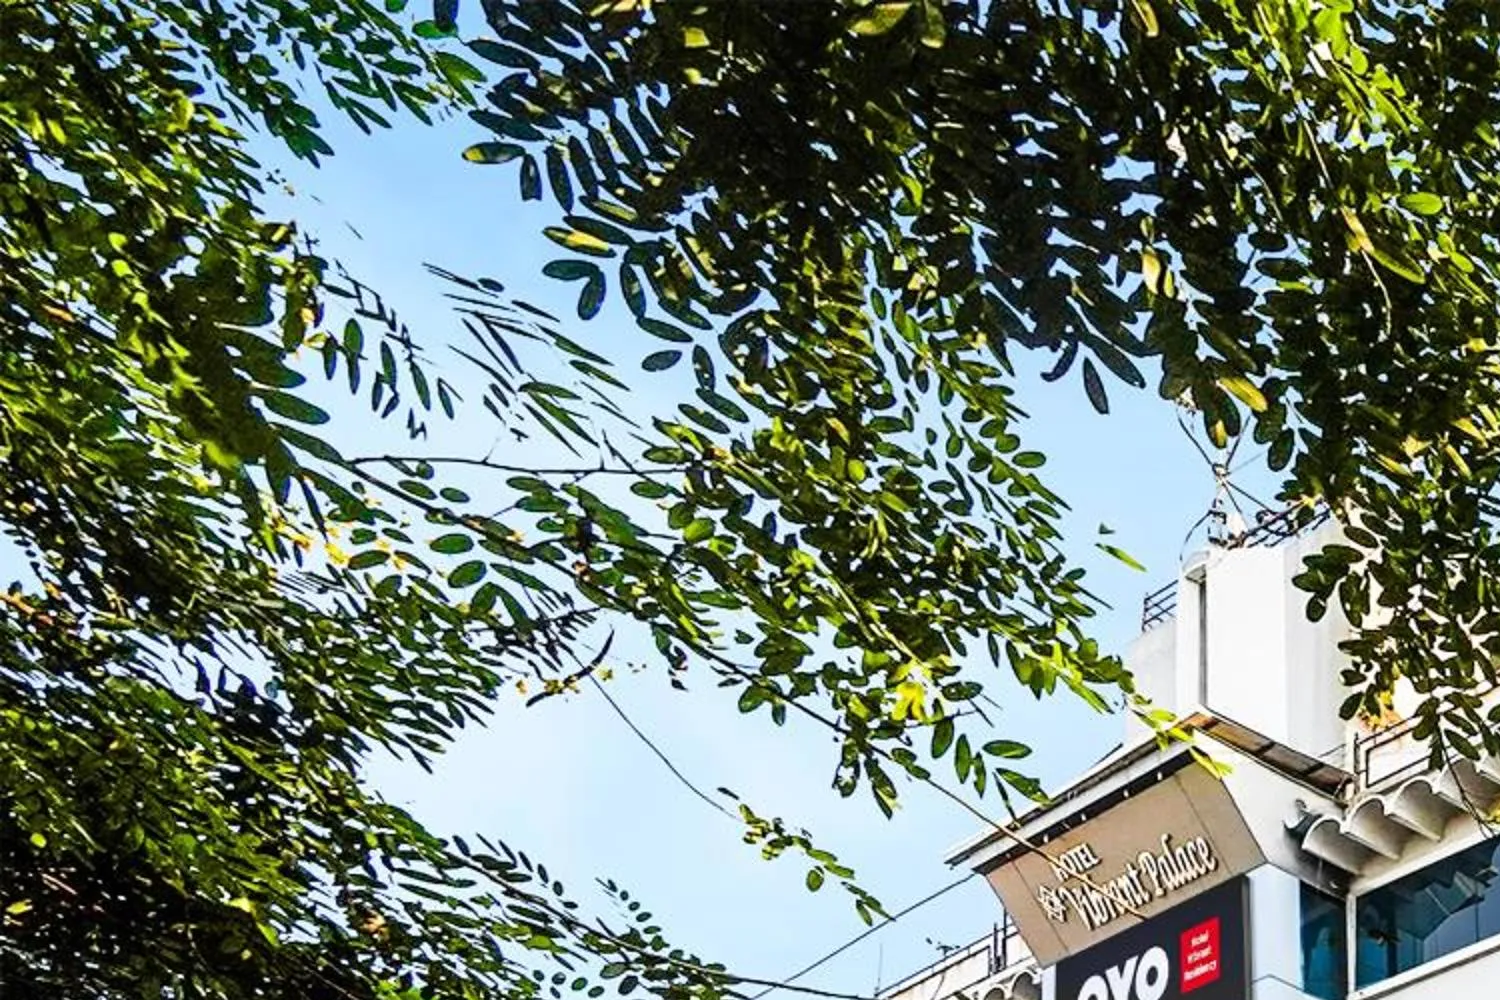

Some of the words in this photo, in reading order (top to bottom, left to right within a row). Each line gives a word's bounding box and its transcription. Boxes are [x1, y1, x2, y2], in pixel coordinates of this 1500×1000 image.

[1052, 843, 1101, 882] HOTEL
[1059, 863, 1152, 930] Vibrant
[1137, 834, 1217, 897] Palace
